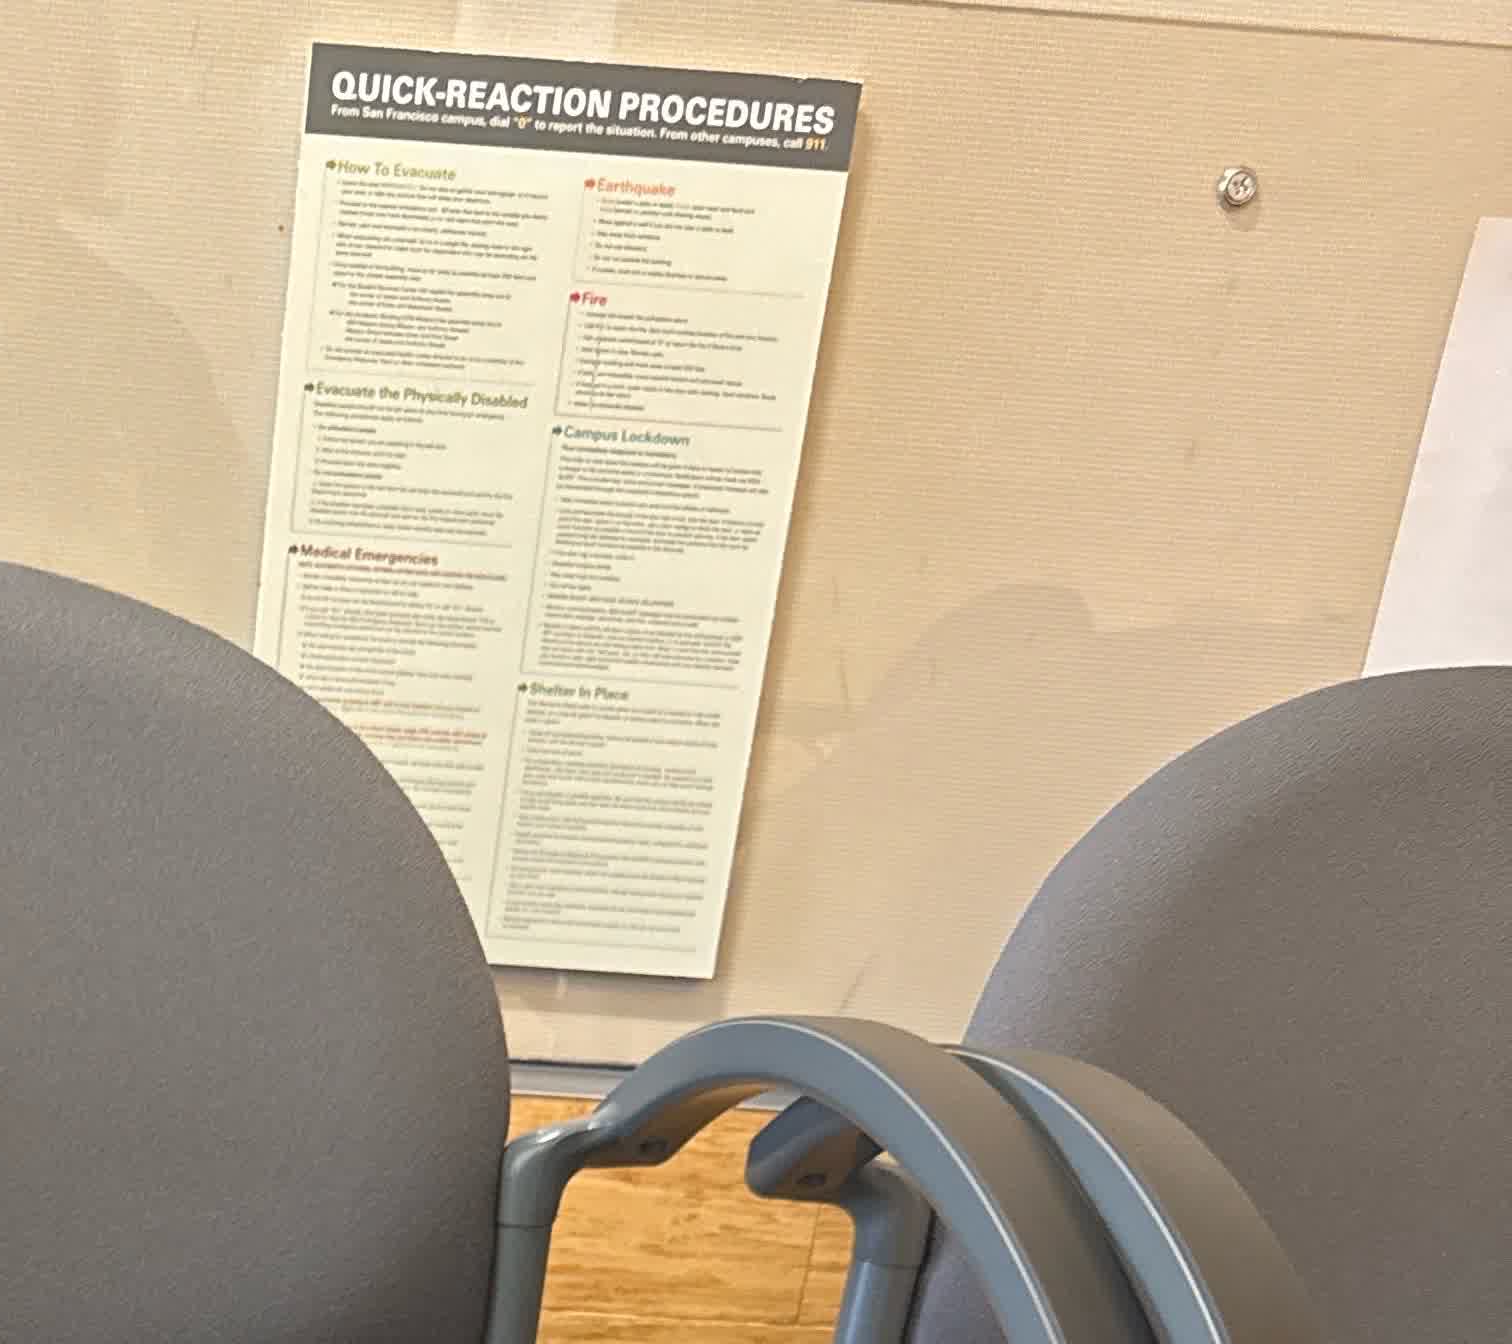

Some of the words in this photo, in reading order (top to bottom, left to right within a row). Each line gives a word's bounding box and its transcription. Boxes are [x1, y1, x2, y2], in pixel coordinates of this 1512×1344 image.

[330, 70, 612, 119] QUICK-REACTION
[618, 90, 836, 136] PROCEDURES
[330, 103, 361, 118] From
[362, 105, 385, 119] San
[386, 107, 440, 123] Francisco
[489, 115, 511, 128] dial
[535, 119, 547, 131] to
[548, 121, 583, 135] report
[585, 122, 605, 136] the
[606, 125, 657, 139] situation.
[659, 127, 688, 141] From
[690, 130, 721, 144] other
[783, 137, 803, 149] call
[338, 160, 371, 176] How
[374, 161, 390, 177] To
[393, 163, 457, 181] Evacuate
[597, 177, 677, 198] Earthquake
[581, 291, 608, 307] Fire
[315, 382, 377, 400] Evacuate
[378, 385, 400, 401] the
[403, 386, 469, 407] Physically
[470, 391, 529, 409] Disabled
[563, 425, 619, 443] Campus
[621, 428, 690, 446] Lockdown
[300, 543, 352, 561] Medical
[354, 547, 439, 567] Emergencies
[529, 681, 577, 698] Shelter
[594, 684, 630, 701] Place
